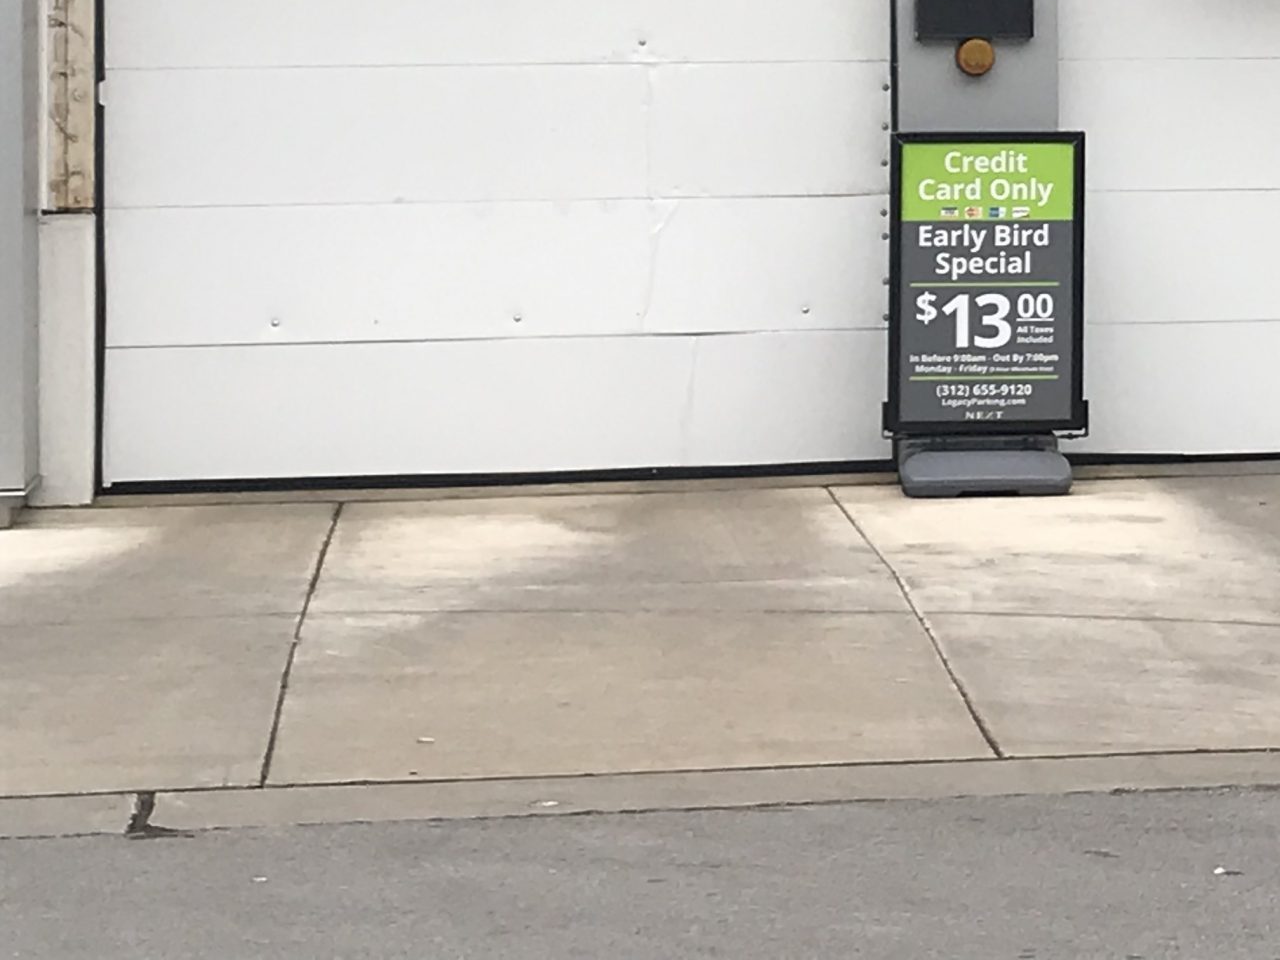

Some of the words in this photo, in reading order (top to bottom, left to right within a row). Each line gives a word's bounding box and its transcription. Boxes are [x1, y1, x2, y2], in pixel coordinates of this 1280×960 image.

[944, 150, 1028, 173] Credit
[918, 178, 981, 201] Card
[990, 178, 1054, 207] Only
[918, 223, 987, 253] Early
[994, 223, 1049, 247] Bird
[935, 250, 1031, 281] Special
[921, 354, 952, 363] Before
[993, 353, 1011, 363] Out
[1012, 353, 1024, 364] By
[915, 365, 952, 374] Monday
[959, 364, 988, 375] Friday
[936, 385, 970, 397] (312)
[972, 384, 1032, 396] 655-9120
[941, 398, 1026, 408] LegacyParking.com
